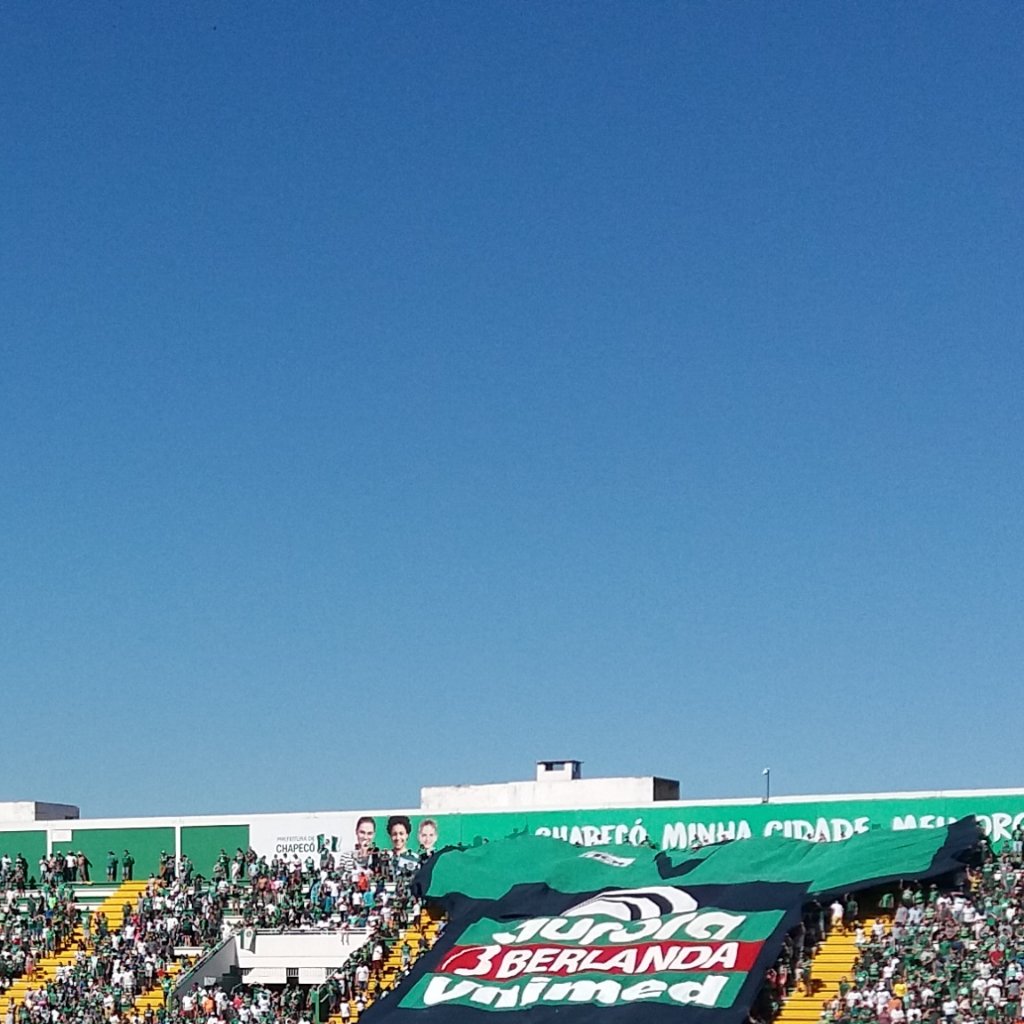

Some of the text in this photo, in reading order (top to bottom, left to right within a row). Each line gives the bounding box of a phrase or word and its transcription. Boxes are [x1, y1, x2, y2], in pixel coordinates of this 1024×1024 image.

[276, 843, 315, 853] CHAPECÓ
[496, 942, 739, 978] BERLANDA
[423, 976, 730, 1008] Unimed
